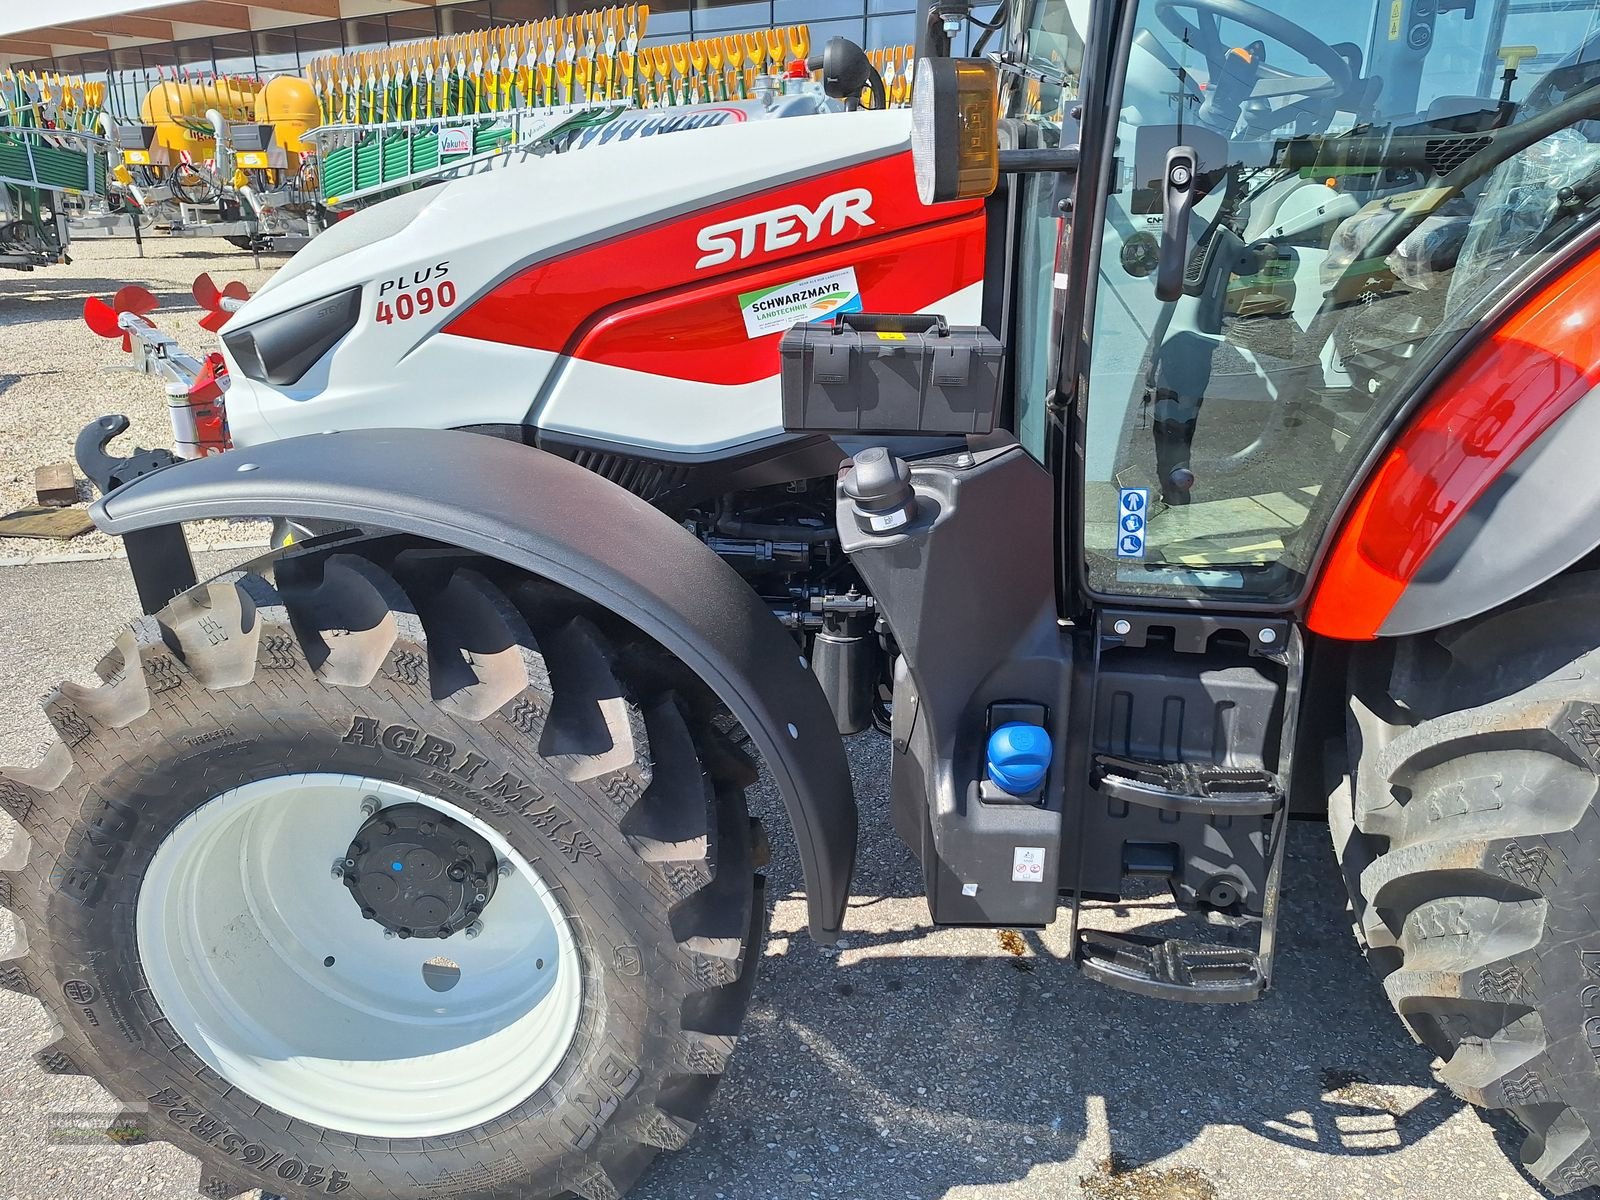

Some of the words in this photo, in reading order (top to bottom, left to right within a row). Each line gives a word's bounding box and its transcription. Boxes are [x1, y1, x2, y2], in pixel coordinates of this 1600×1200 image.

[441, 137, 469, 152] Vakutec
[695, 188, 876, 270] STEYR
[380, 261, 450, 297] PLUS
[752, 282, 840, 313] SCHWARZMAYR
[375, 280, 456, 325] 4090
[756, 303, 808, 321] LANDTECHNIK
[341, 715, 489, 782] AGRI
[482, 771, 602, 864] MAX
[147, 1086, 351, 1195] 440/65R24
